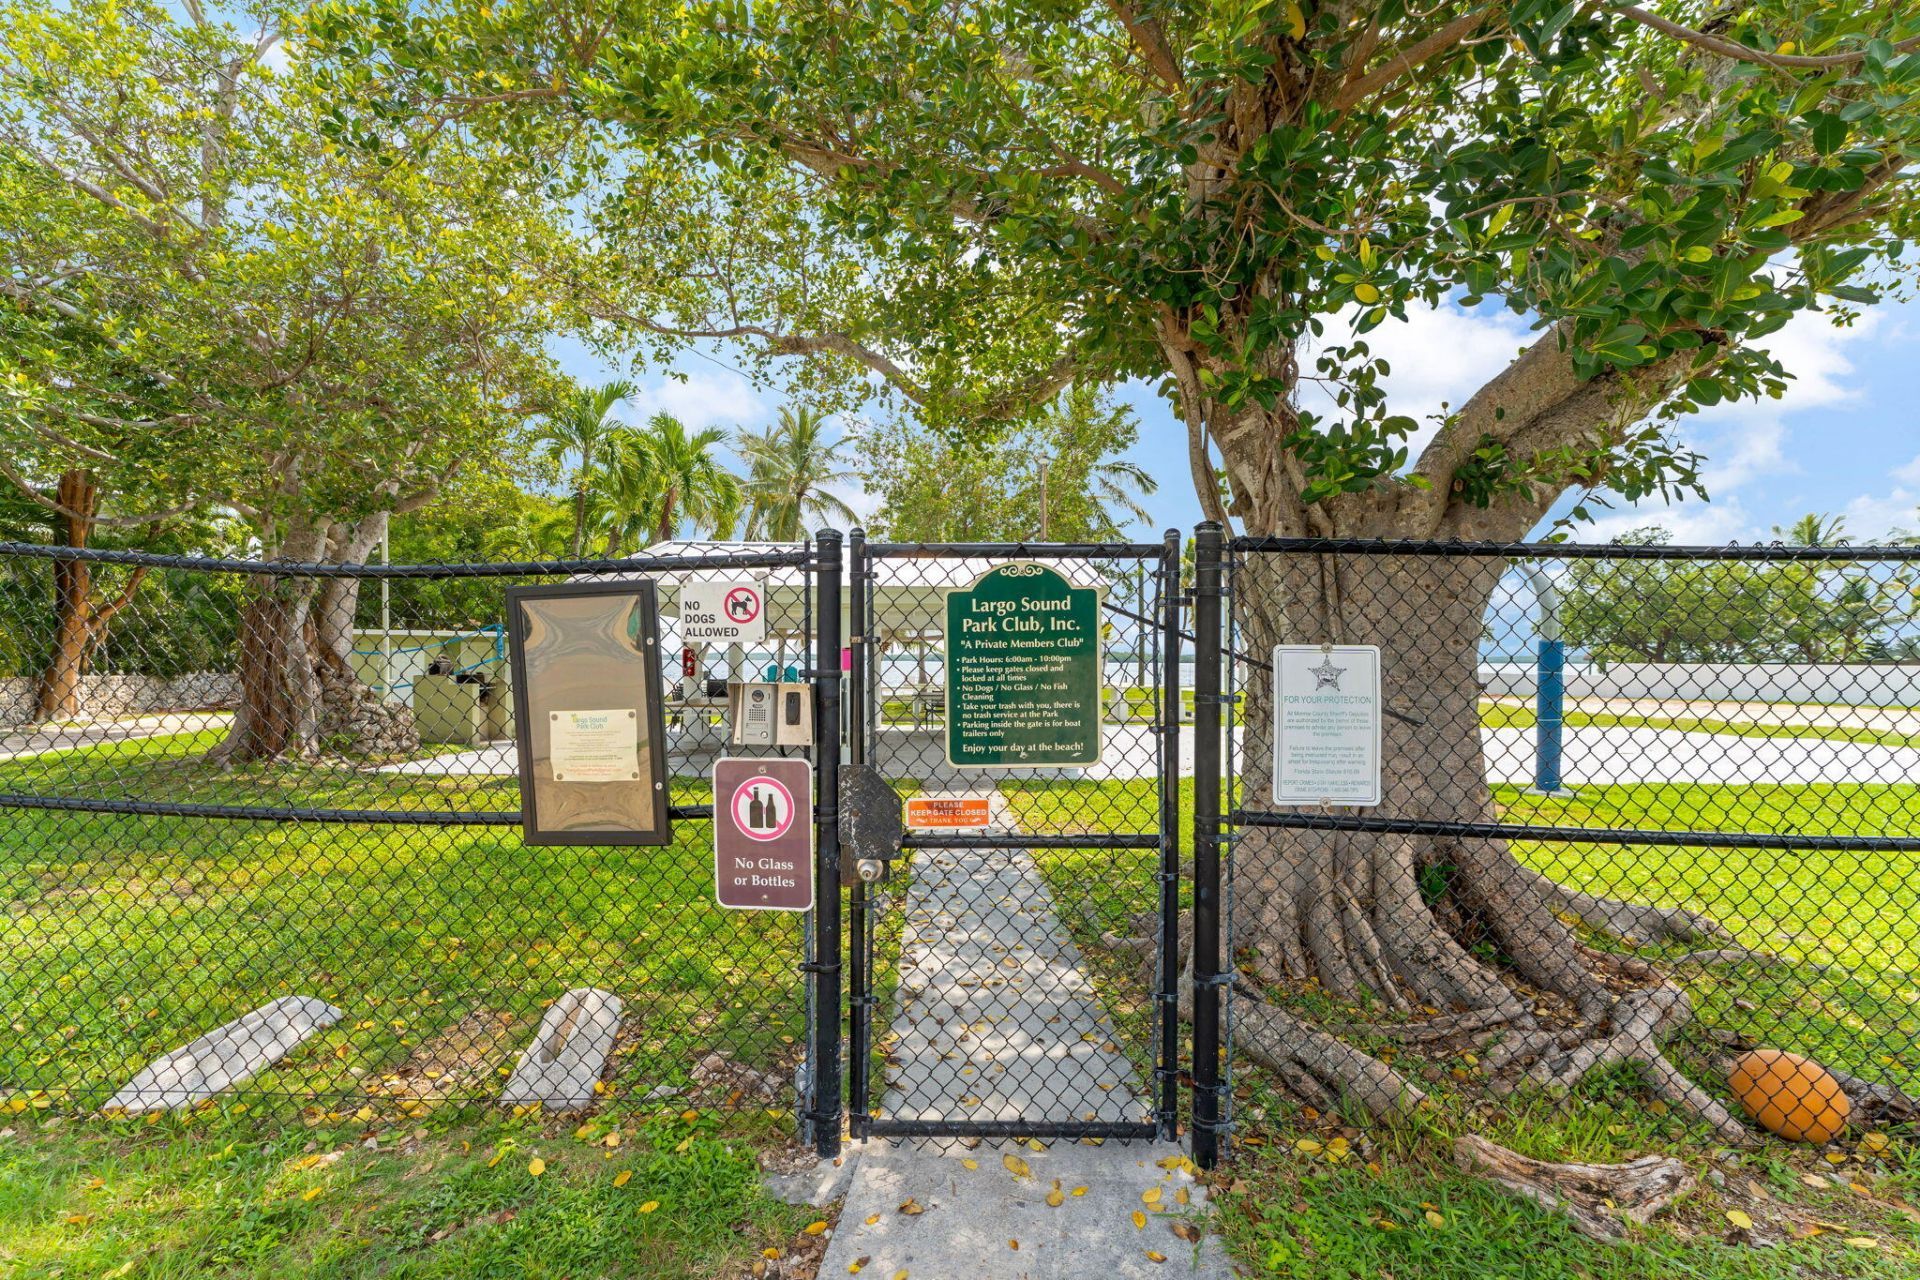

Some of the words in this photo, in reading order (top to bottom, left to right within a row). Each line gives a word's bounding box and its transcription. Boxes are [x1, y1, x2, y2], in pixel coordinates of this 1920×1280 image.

[685, 601, 700, 610] NO
[972, 598, 1016, 616] Largo
[1021, 595, 1071, 612] Sound
[685, 614, 715, 623] DOGS
[962, 617, 997, 632] Park
[1002, 616, 1044, 634] Club,
[1051, 617, 1080, 631] Inc.
[685, 627, 739, 637] ALLOWED
[961, 640, 972, 649] "A
[975, 640, 1008, 649] Private
[1010, 638, 1054, 648] Members
[1057, 638, 1084, 647] Club"
[1039, 655, 1072, 664] 10:00pm
[975, 684, 994, 693] Dogs
[962, 694, 994, 702] Cleaning
[1284, 696, 1300, 704] FOR
[1301, 696, 1322, 704] YOUR
[1324, 696, 1372, 704] PROTECTION
[963, 744, 986, 754] Enjoy
[1010, 743, 1025, 753] day
[1054, 742, 1084, 750] beach!
[735, 858, 754, 869] No
[758, 858, 794, 870] Glass
[734, 877, 747, 886] or
[752, 874, 795, 887] Bottles
